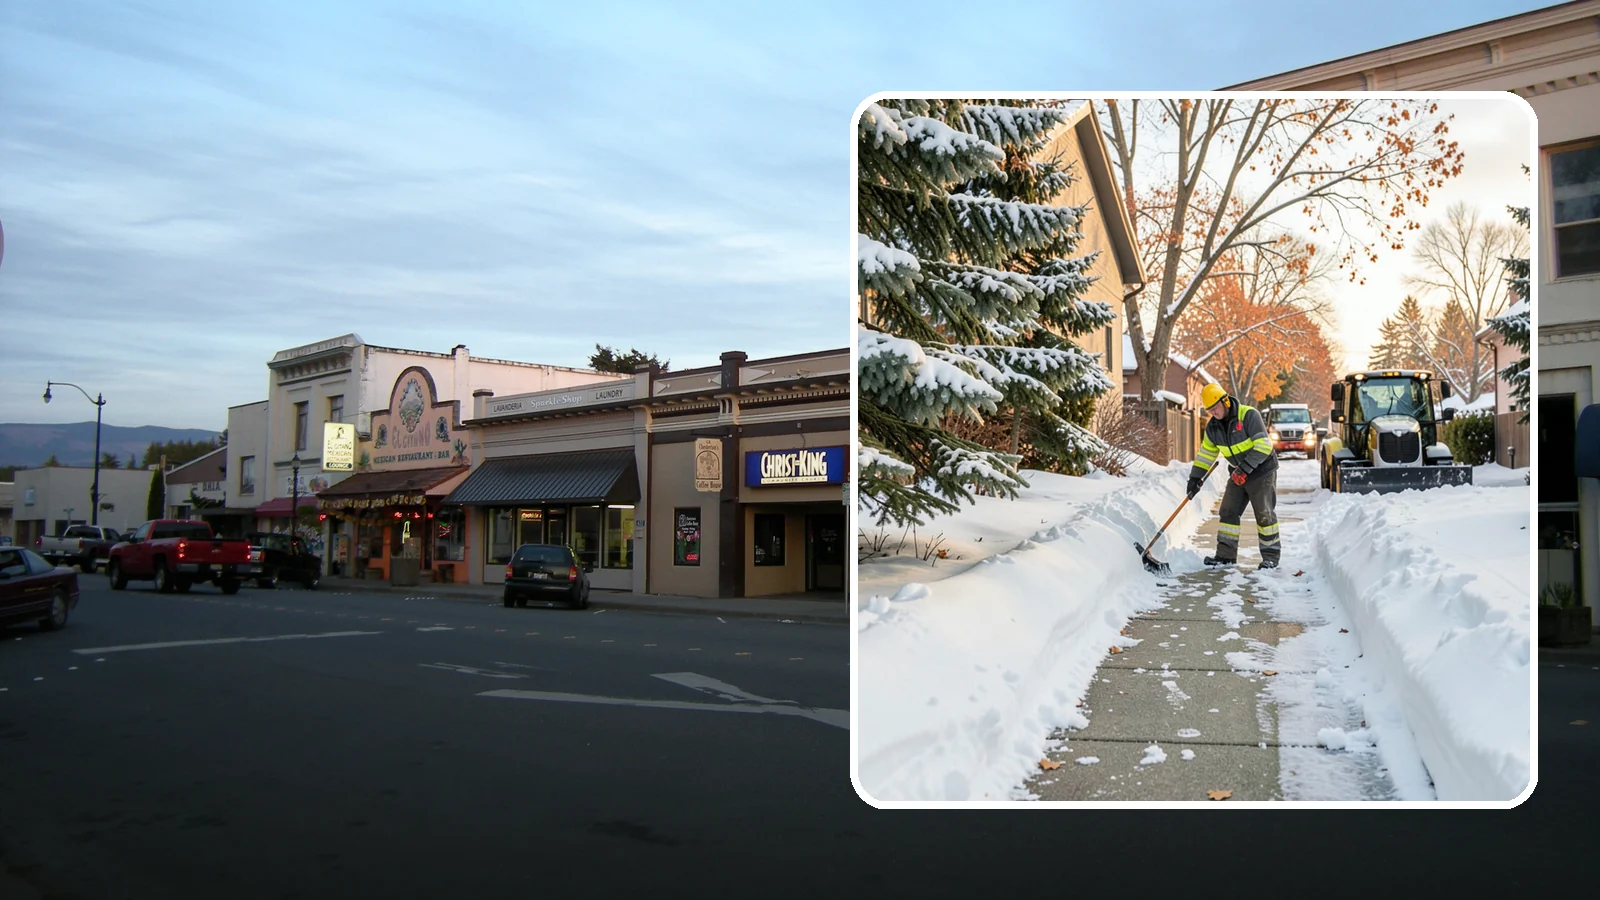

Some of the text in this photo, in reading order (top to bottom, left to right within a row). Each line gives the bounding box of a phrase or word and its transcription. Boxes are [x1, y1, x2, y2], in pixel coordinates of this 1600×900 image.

[595, 389, 623, 399] LAUNDRY
[493, 402, 522, 412] LAVANDERIA
[531, 394, 583, 409] Sparkle Shop
[373, 454, 396, 464] MEXICAN
[398, 451, 433, 462] RESTAURANT
[438, 450, 450, 459] BAR
[761, 450, 827, 477] CHRIST KING
